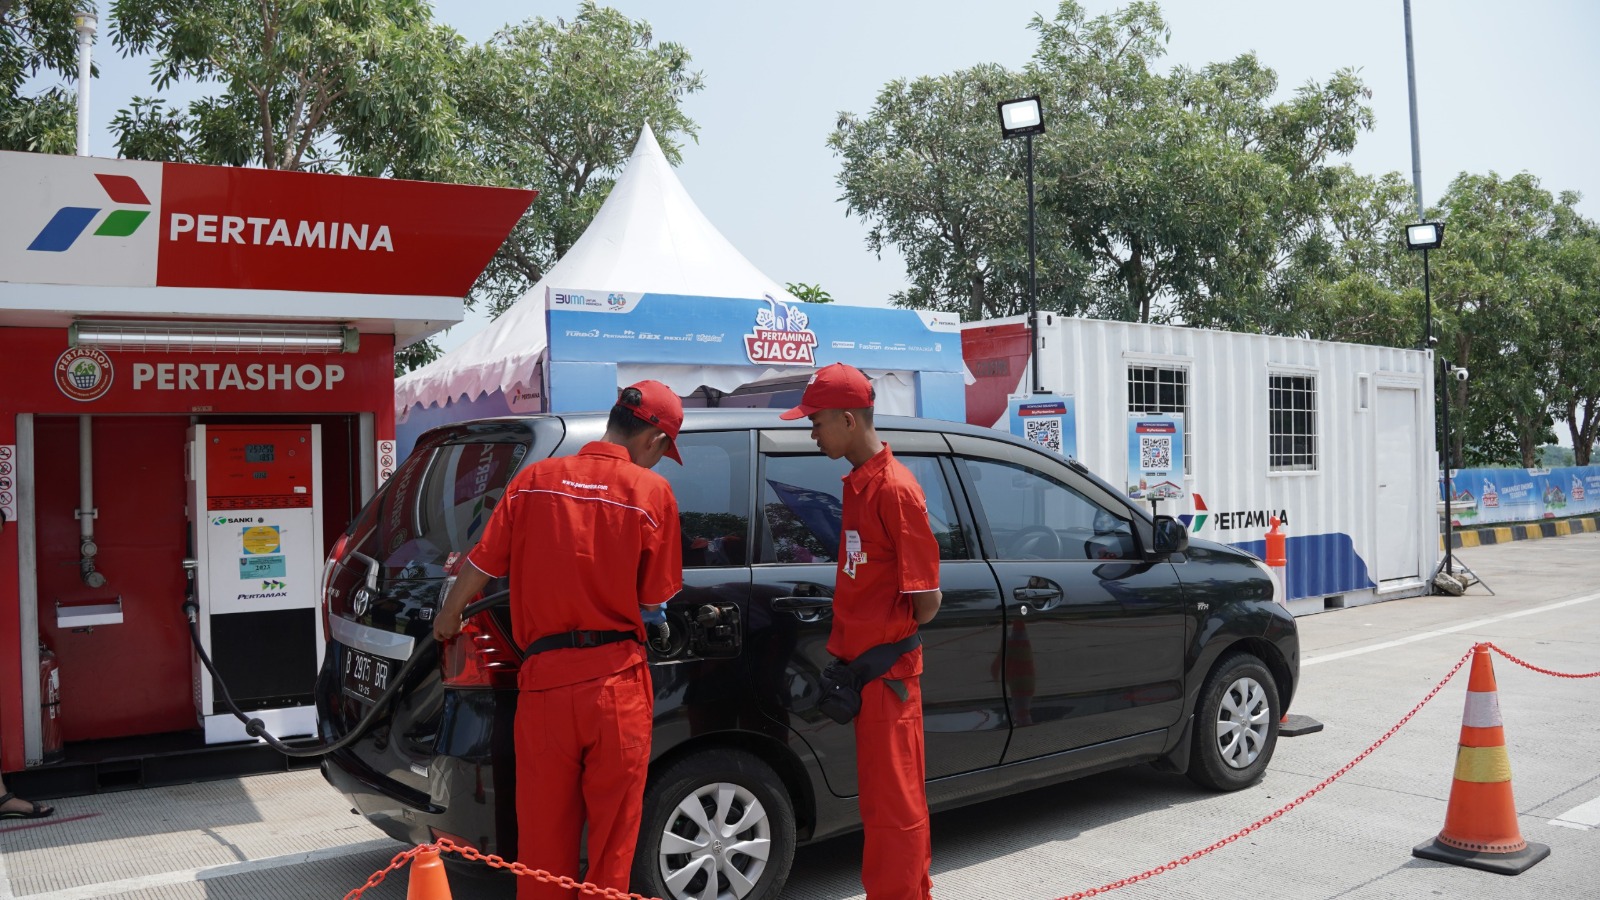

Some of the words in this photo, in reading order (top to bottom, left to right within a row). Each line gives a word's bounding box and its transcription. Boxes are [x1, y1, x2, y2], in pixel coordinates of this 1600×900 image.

[170, 213, 394, 252] PERTAMINA
[762, 331, 812, 343] PERTAMINA
[59, 348, 110, 372] PERTASHOP
[752, 340, 810, 361] SIAGA
[132, 362, 346, 391] PERTASHOP
[237, 591, 288, 600] PERTAMAX
[346, 650, 352, 674] B
[353, 654, 372, 682] 2975
